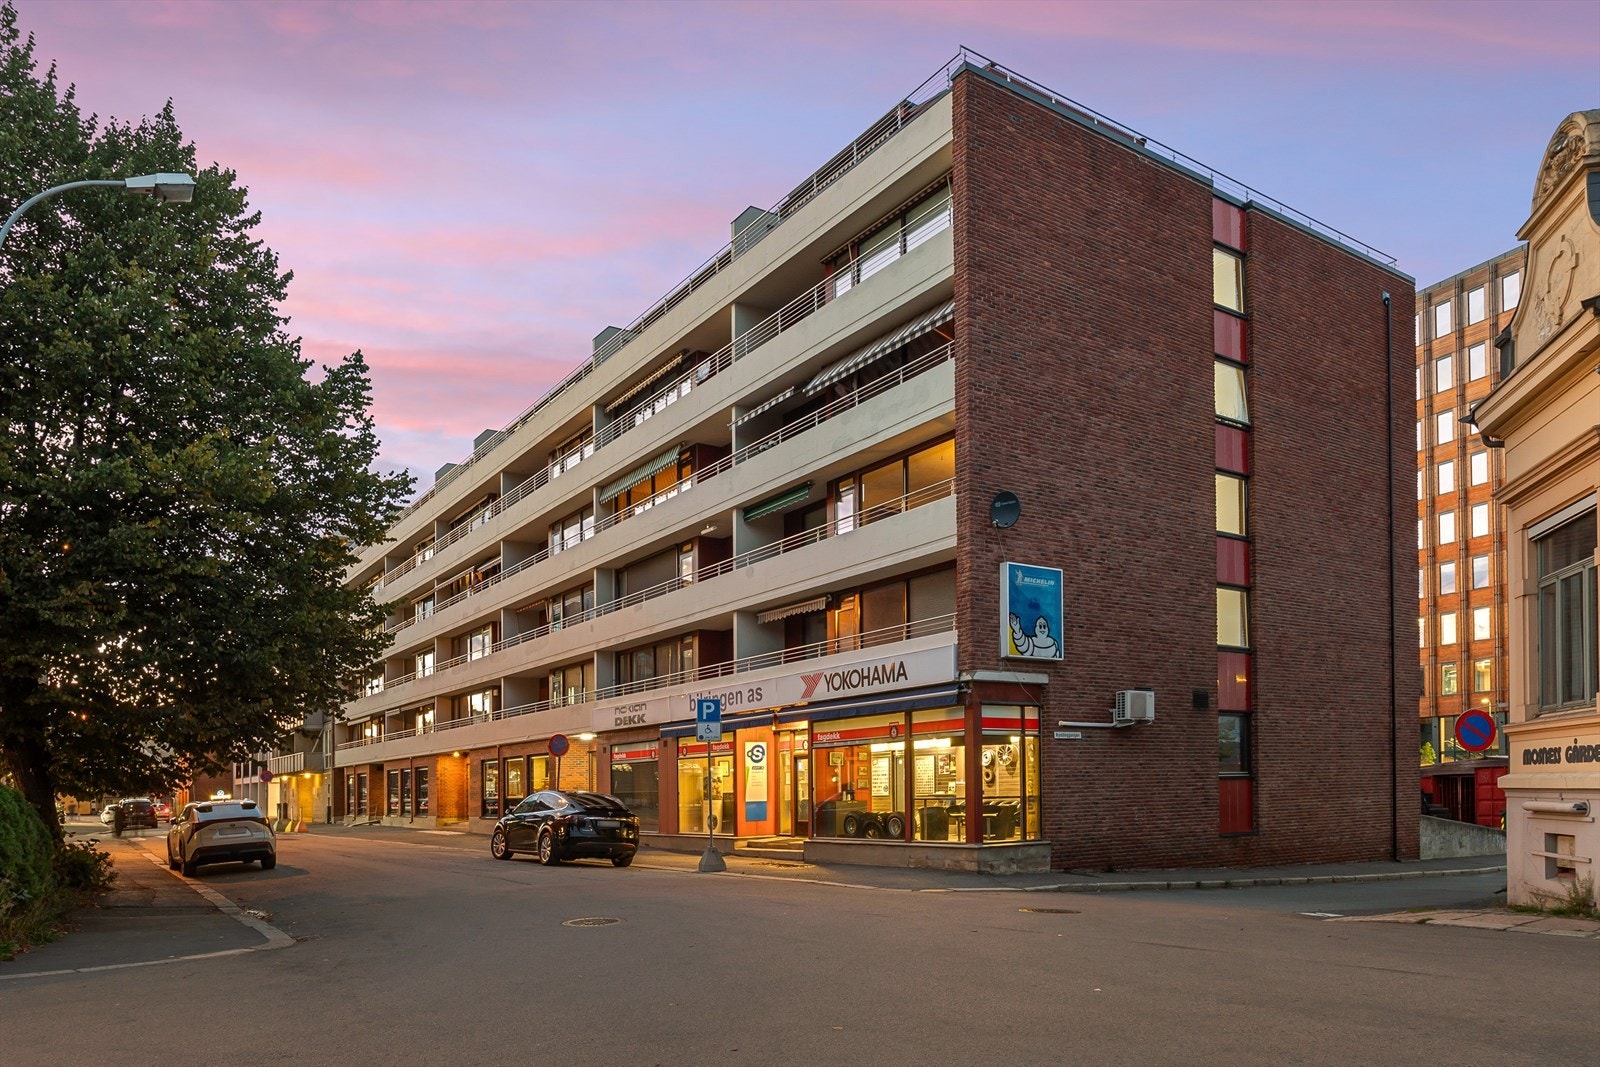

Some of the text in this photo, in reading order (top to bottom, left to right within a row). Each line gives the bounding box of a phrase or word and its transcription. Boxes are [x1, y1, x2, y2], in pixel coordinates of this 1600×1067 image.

[1023, 577, 1055, 586] MICHELIN
[824, 661, 908, 692] YOKOHAMA
[689, 687, 763, 712] bigen as
[702, 702, 715, 720] P
[614, 714, 647, 727] DEKK
